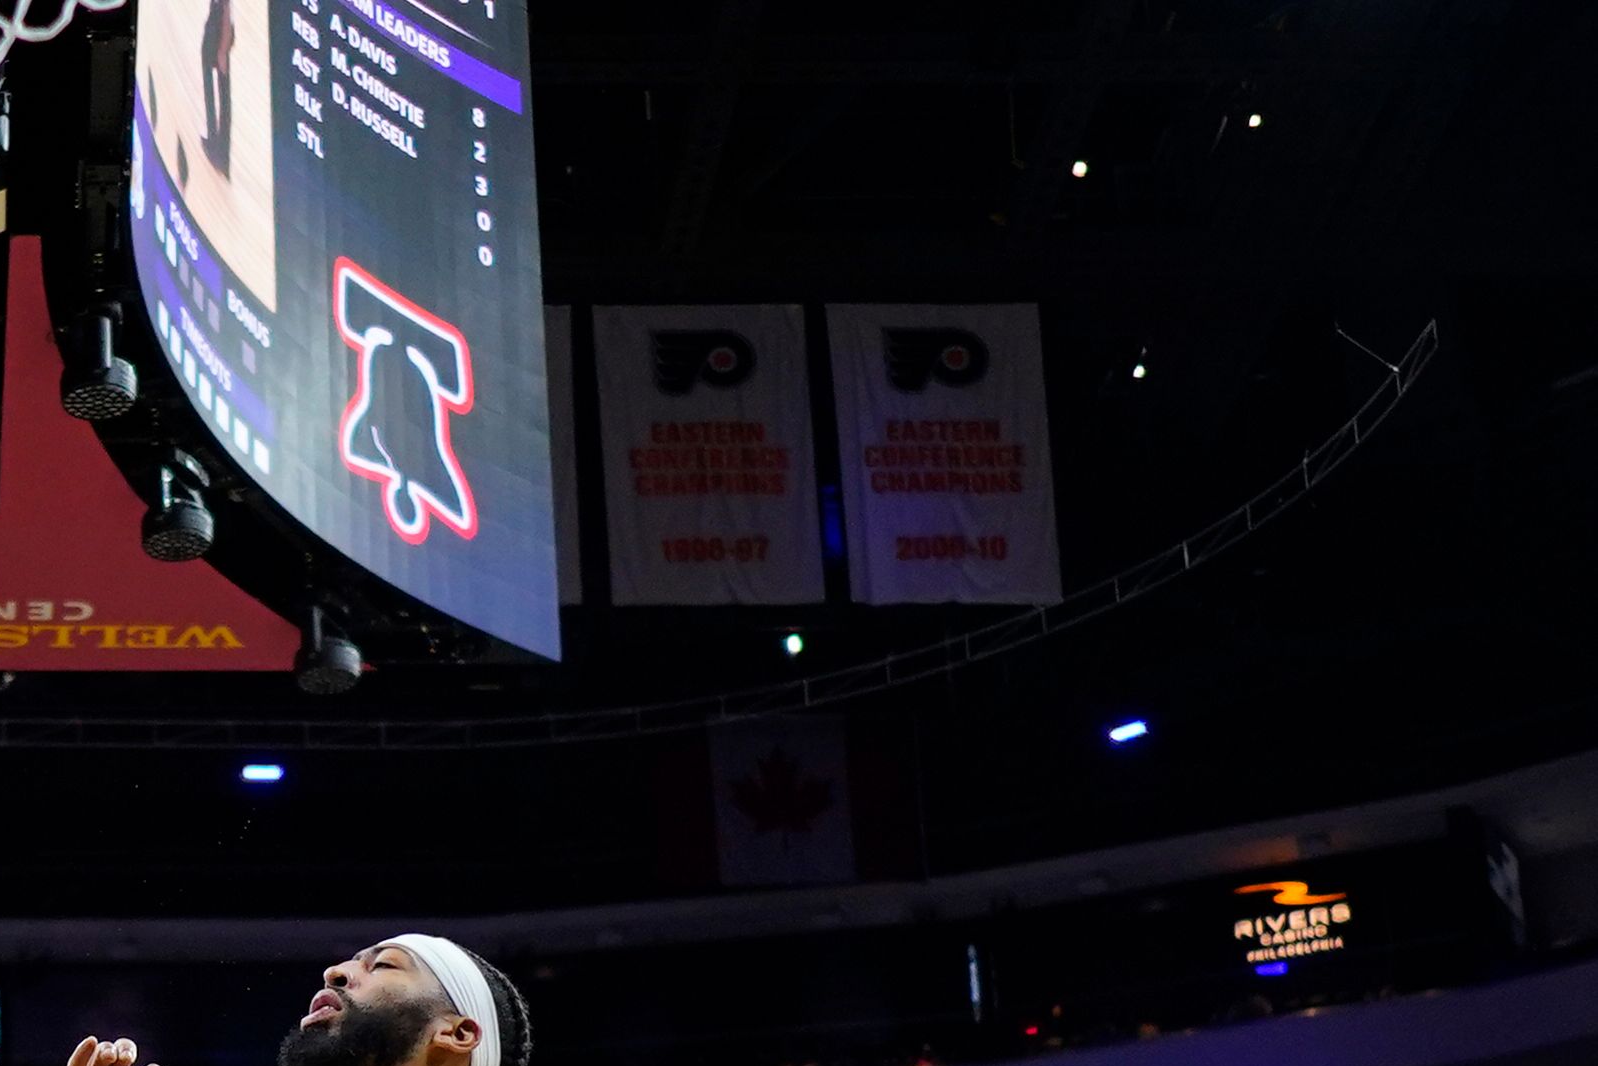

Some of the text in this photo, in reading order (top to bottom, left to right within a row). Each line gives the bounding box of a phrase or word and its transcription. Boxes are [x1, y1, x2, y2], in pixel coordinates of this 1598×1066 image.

[330, 14, 485, 128] A. DAVIS 8
[376, 5, 451, 68] LEADERS
[291, 11, 320, 49] REB
[351, 65, 425, 129] CHRISTIE
[473, 142, 487, 164] 2
[291, 48, 489, 196] AST D. RUSSELL 3
[294, 83, 491, 232] BLK 0
[297, 122, 493, 267] STL 0
[650, 421, 765, 444] EASTERN
[865, 444, 1026, 468] CONFERENCE
[886, 419, 1001, 443] EASTERN
[870, 470, 1023, 495] CHAMPIONS
